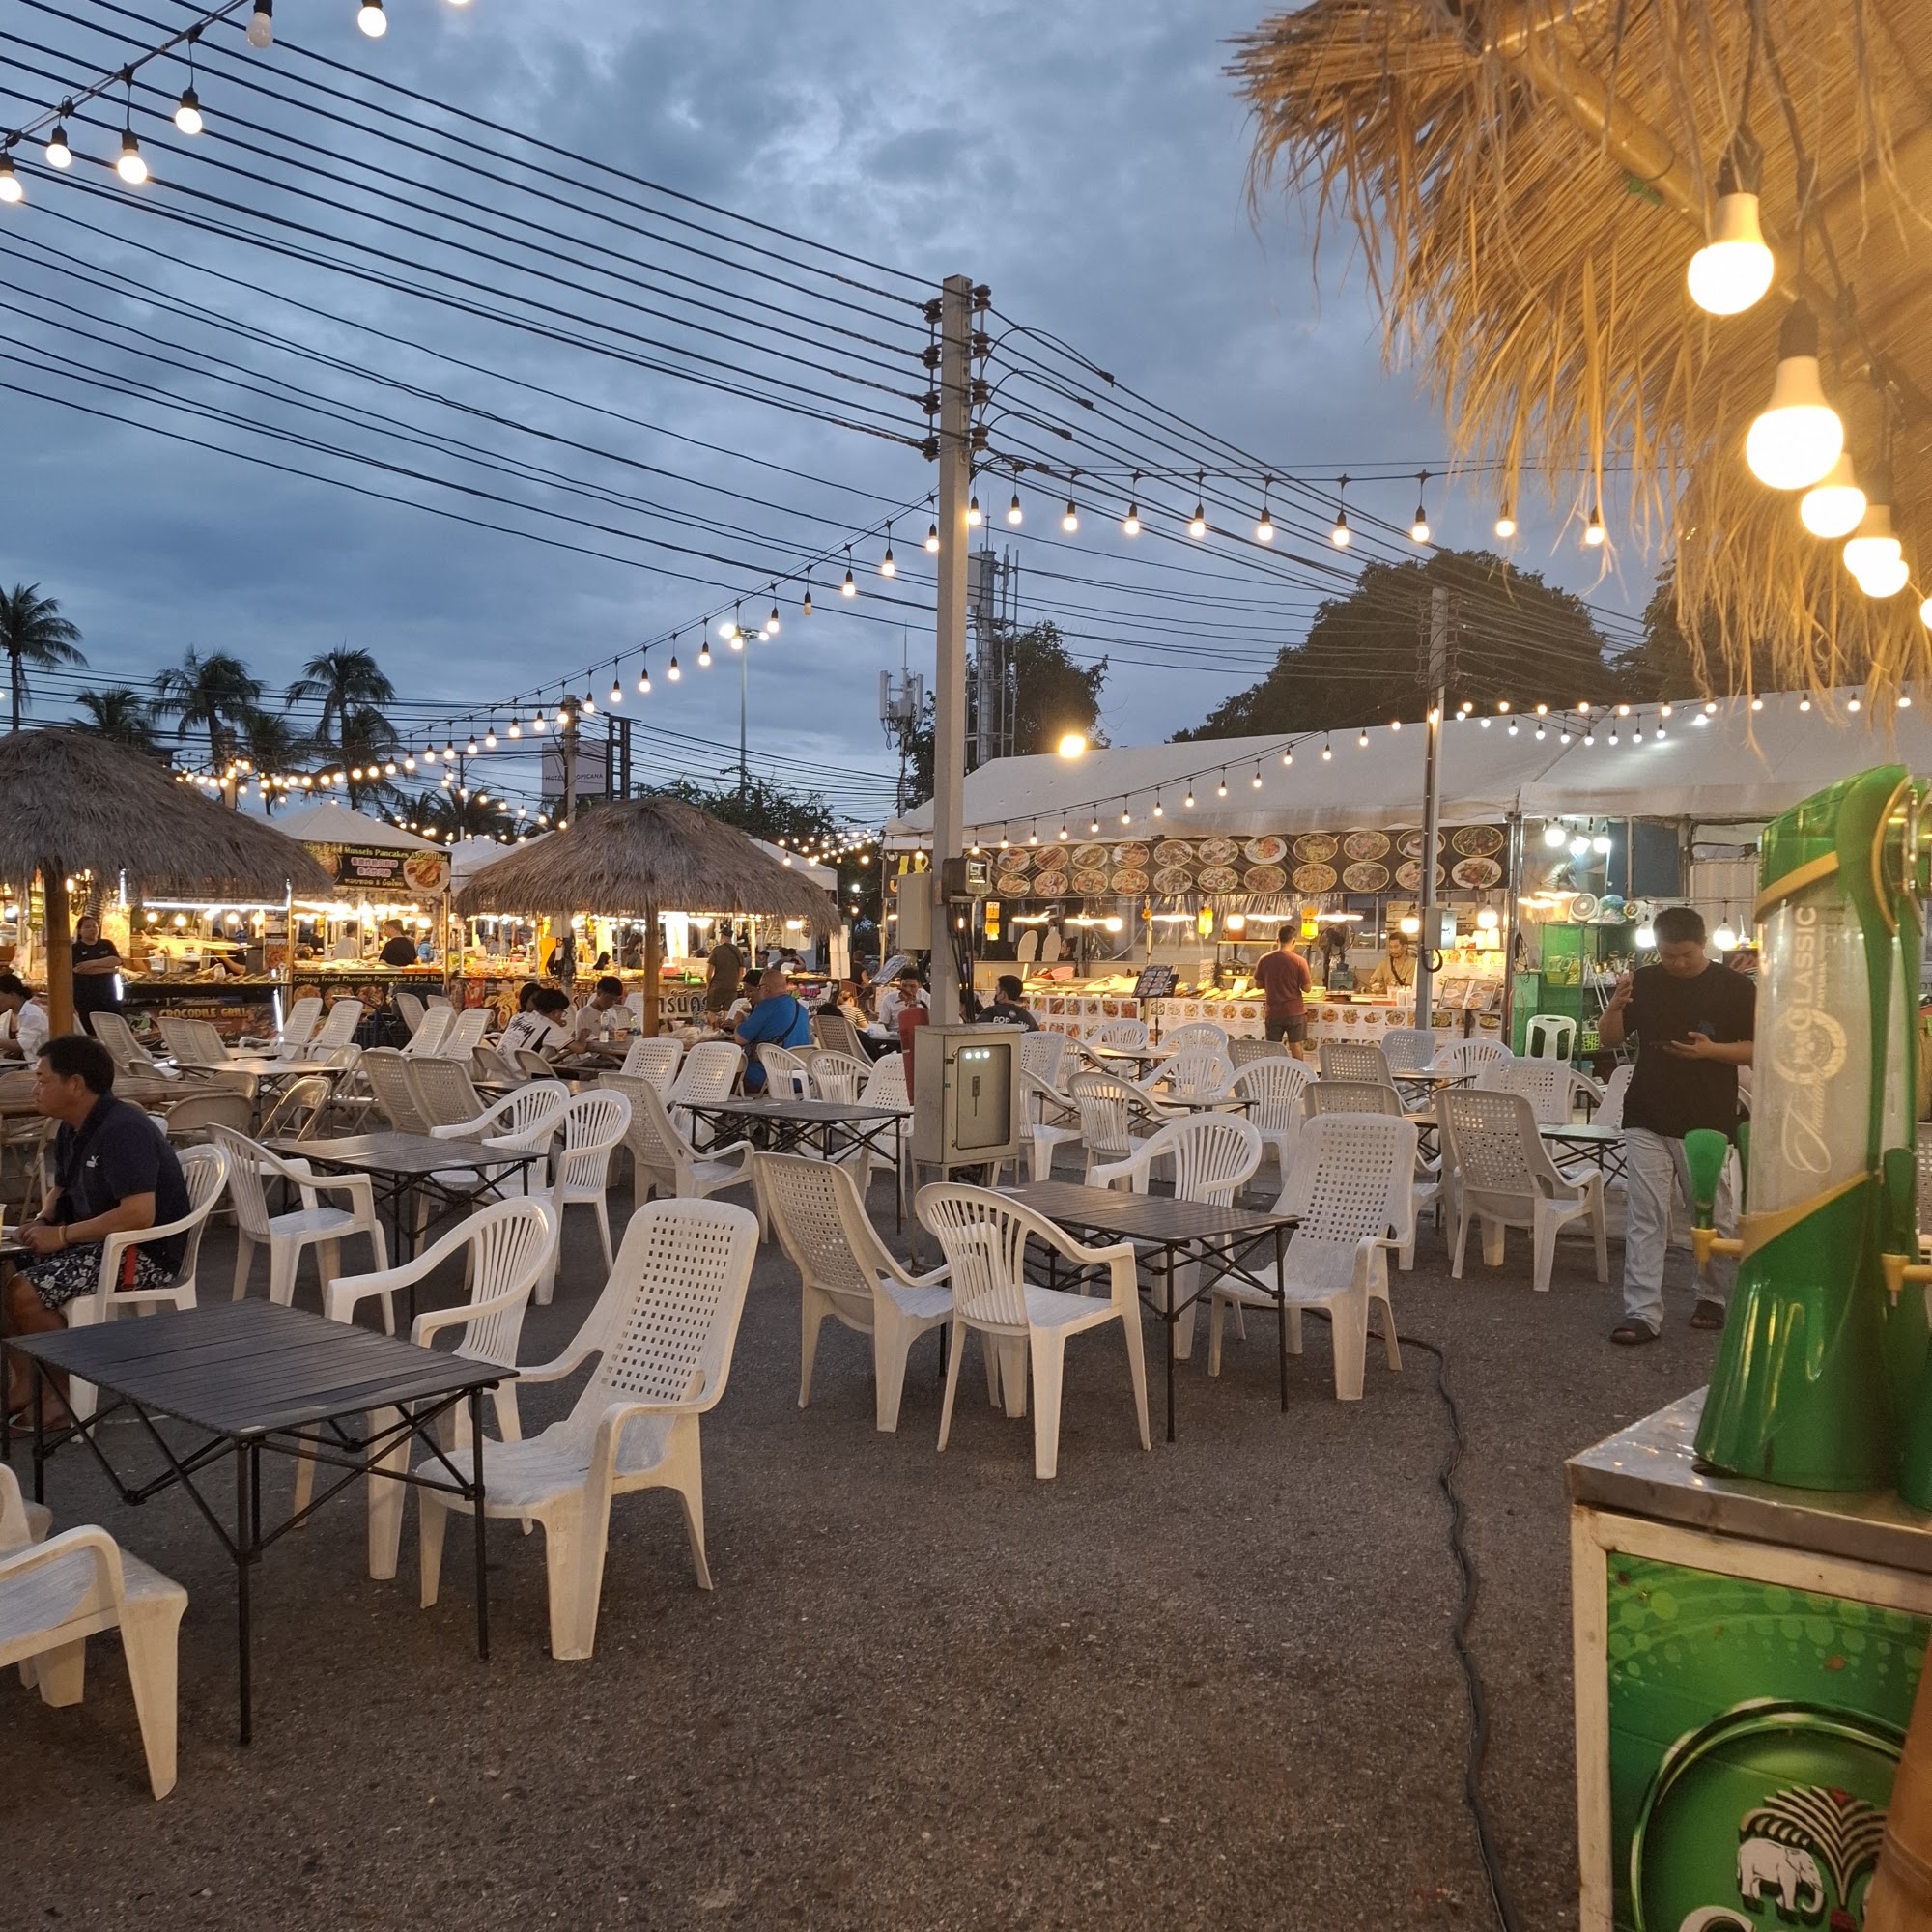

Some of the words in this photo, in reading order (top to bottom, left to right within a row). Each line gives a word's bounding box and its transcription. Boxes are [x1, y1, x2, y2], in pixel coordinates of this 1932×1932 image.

[344, 846, 373, 856] Mussels
[375, 849, 409, 858] Pancakes
[1787, 906, 1817, 1032] CLASSIC
[159, 1007, 217, 1018] CROCODILE
[221, 1008, 248, 1018] GRILL
